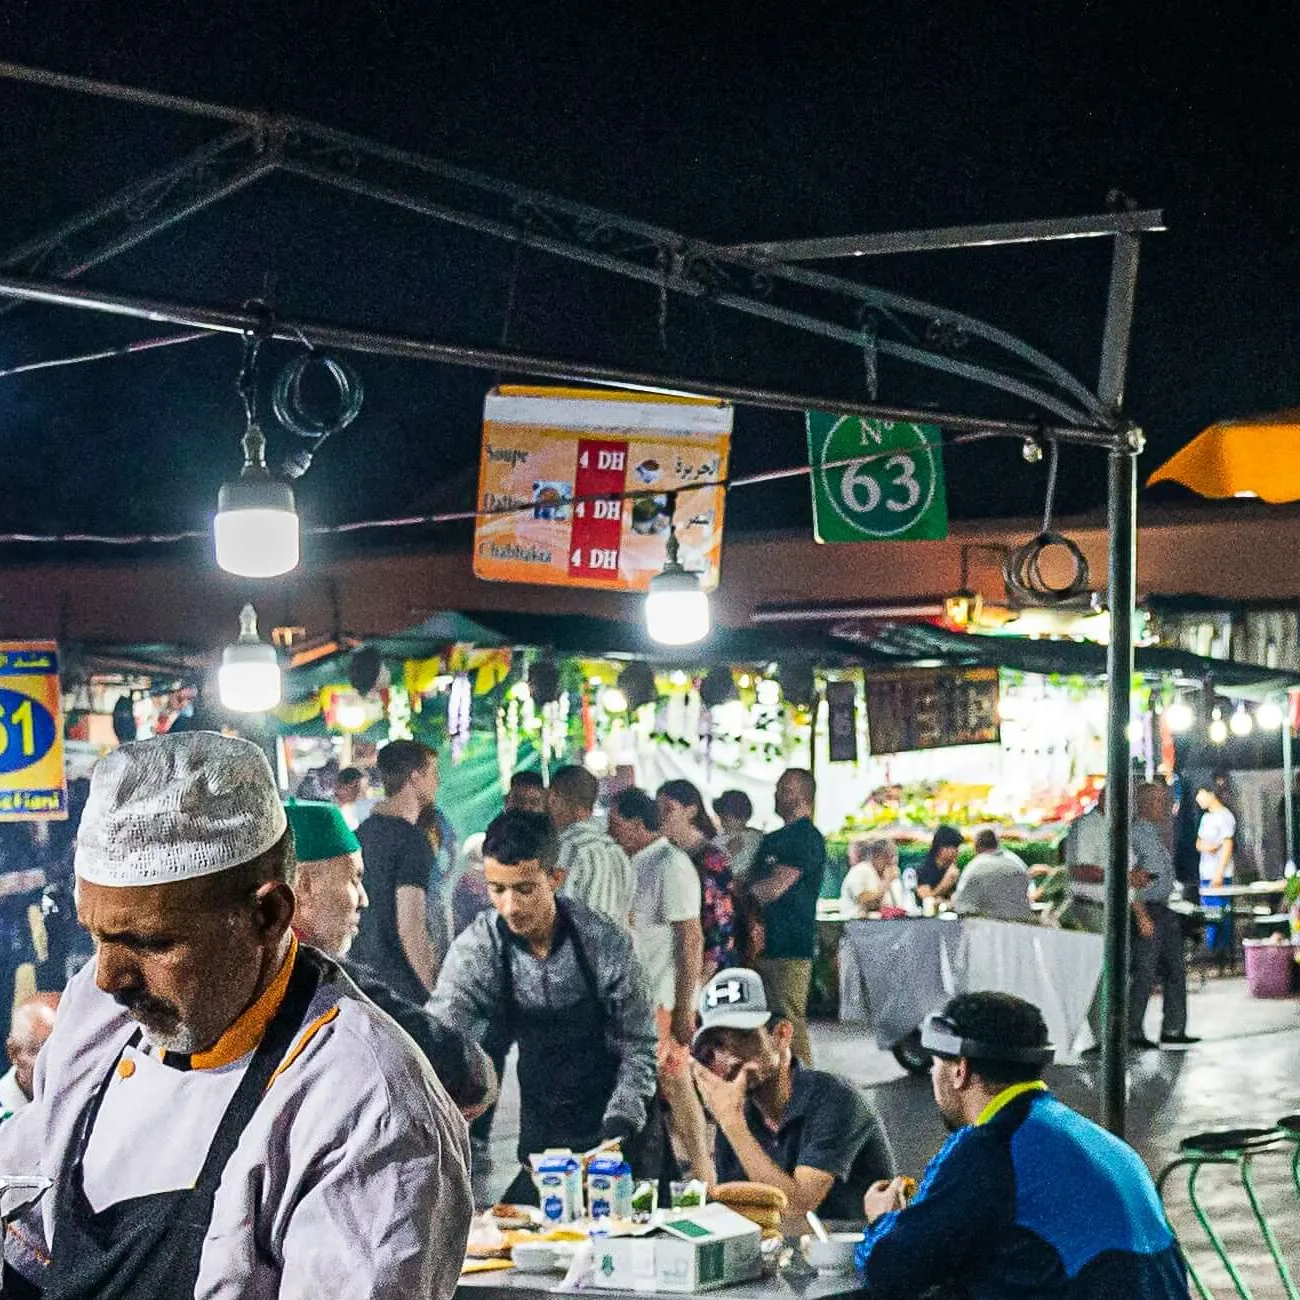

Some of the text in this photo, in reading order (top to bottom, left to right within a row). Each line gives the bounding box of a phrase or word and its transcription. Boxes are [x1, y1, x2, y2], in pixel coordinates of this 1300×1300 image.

[579, 451, 589, 469] 4
[598, 451, 626, 471] DH
[841, 454, 920, 512] 63
[575, 501, 585, 518] 4
[593, 501, 621, 521] DH
[571, 550, 582, 568] 4
[590, 550, 618, 570] DH
